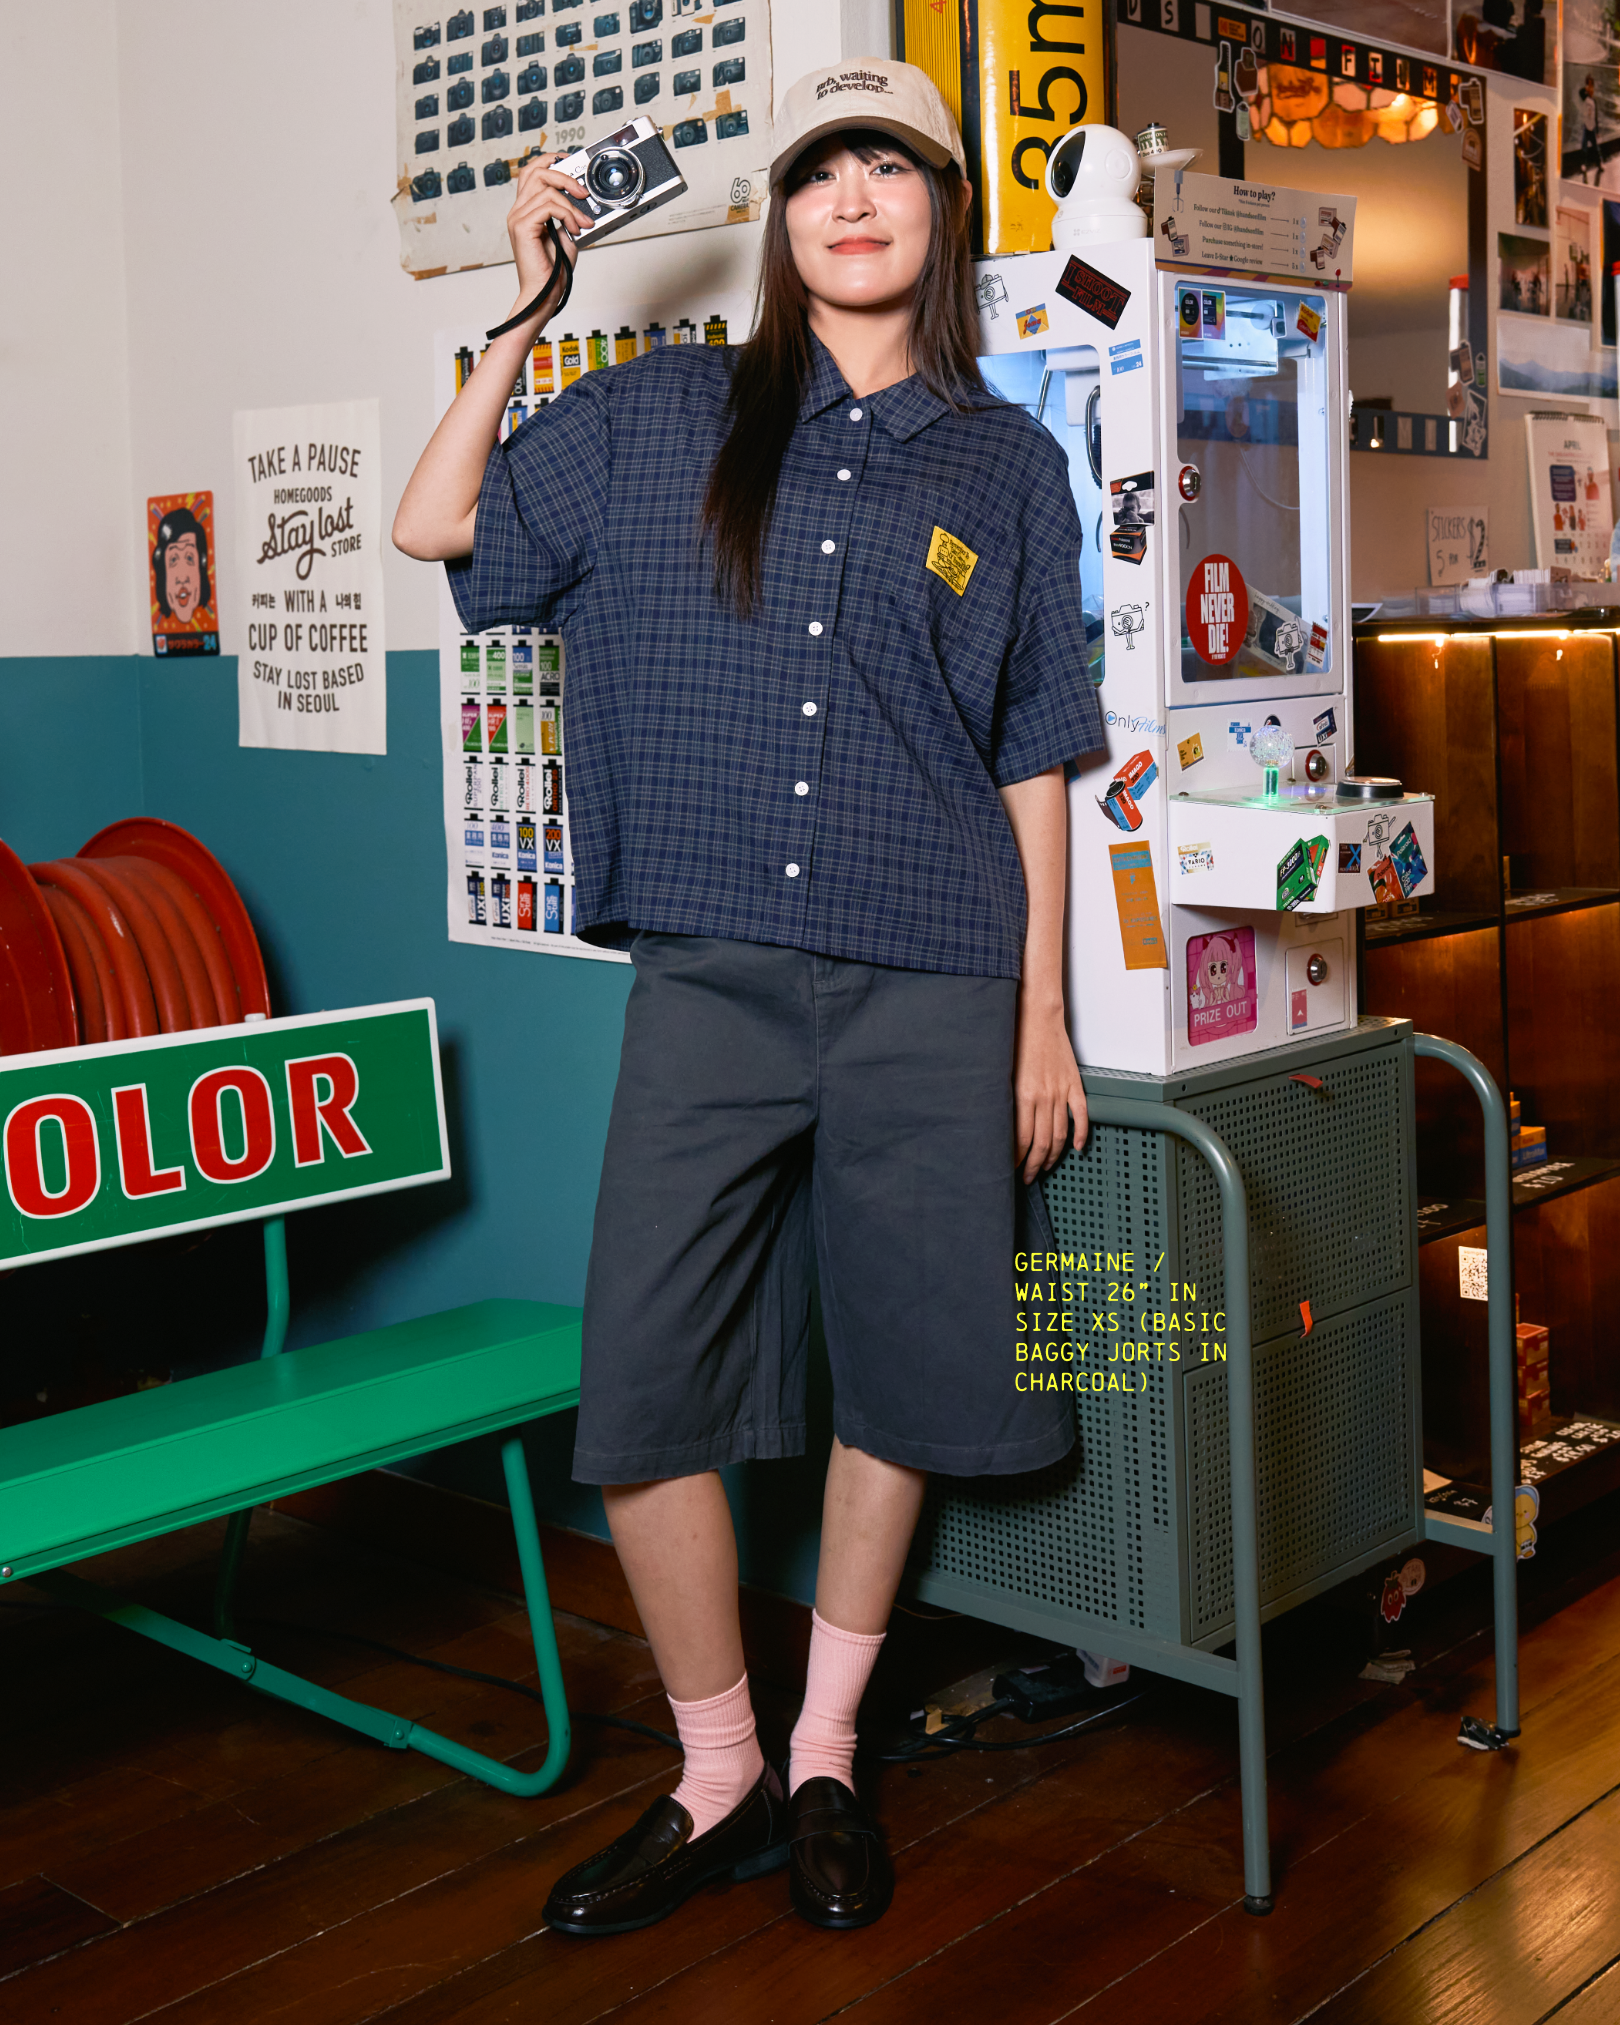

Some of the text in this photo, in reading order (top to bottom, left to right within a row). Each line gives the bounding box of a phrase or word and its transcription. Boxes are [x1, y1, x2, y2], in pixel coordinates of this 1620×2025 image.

[839, 70, 889, 87] waiting
[817, 89, 829, 100] to
[555, 126, 586, 145] 1990
[1233, 185, 1276, 203] How to play?
[1193, 204, 1208, 212] Follow
[1199, 220, 1214, 228] Follow
[1202, 236, 1222, 245] Purchase
[1224, 239, 1246, 250] something
[1202, 251, 1214, 259] Leave
[1234, 254, 1248, 264] Google
[1073, 287, 1107, 316] FILM
[1074, 270, 1124, 315] SHOOT
[562, 345, 579, 353] Kodak
[564, 356, 579, 365] Gold
[1563, 440, 1581, 450] APRIL
[248, 443, 361, 483] TAKE A PAUSE
[273, 486, 332, 504] HOMEGOODS
[1431, 515, 1467, 542] STICKERS
[256, 496, 354, 581] Stay lost
[331, 533, 362, 557] STORE
[1204, 562, 1230, 593] FILM
[284, 590, 327, 613] WITH A
[1200, 592, 1235, 624] NEVER
[203, 634, 217, 651] 24
[248, 623, 368, 652] CUP OF COFFEE
[1208, 622, 1229, 654] DIE!
[512, 652, 524, 662] 100
[540, 662, 552, 670] 100
[253, 660, 364, 691] STAY LOST BASED
[277, 690, 340, 713] IN SEOUL
[542, 711, 552, 720] 100
[1128, 761, 1142, 779] IMAGO
[465, 766, 473, 805] Rollei
[490, 767, 498, 806] Rollei
[516, 768, 525, 808] Rollei
[543, 768, 552, 810] Rollei
[1122, 789, 1134, 810] IMAGO
[518, 827, 534, 838] 100
[546, 829, 562, 840] 200
[520, 838, 534, 850] VX
[546, 839, 562, 852] VX
[1396, 837, 1411, 856] Polaroid
[518, 852, 536, 860] Konica
[1188, 858, 1205, 866] VARIO
[545, 862, 563, 870] Konica
[1194, 1001, 1248, 1027] PRIZE OUT
[3, 1052, 373, 1220] OLOR
